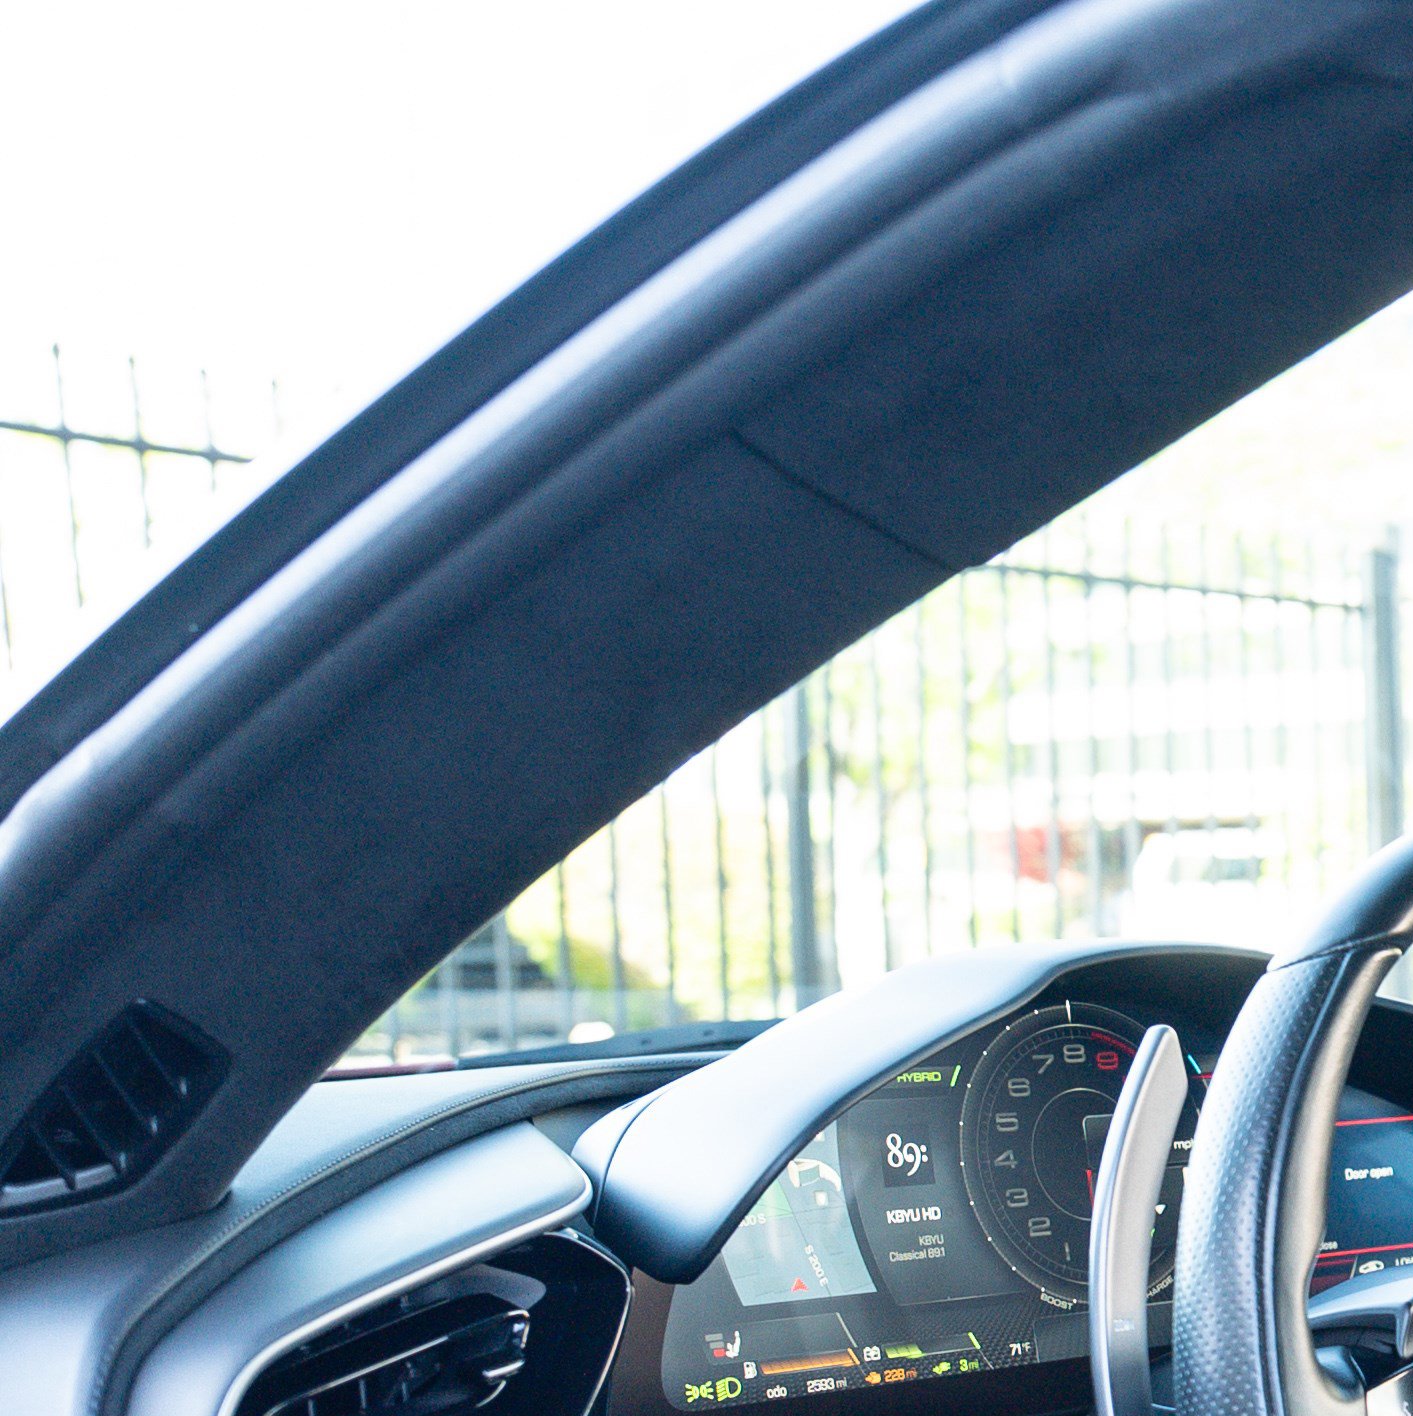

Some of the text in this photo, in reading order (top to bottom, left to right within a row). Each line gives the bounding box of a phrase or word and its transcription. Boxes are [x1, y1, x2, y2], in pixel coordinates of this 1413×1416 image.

[1063, 1044, 1086, 1063] 8
[1096, 1051, 1118, 1070] 9
[1032, 1054, 1055, 1074] 7
[1008, 1078, 1030, 1097] 6
[996, 1112, 1019, 1132] 5
[994, 1149, 1018, 1168] 4
[1344, 1166, 1394, 1181] Door open
[1005, 1188, 1029, 1207] 3
[886, 1206, 942, 1224] KBYU HD
[1028, 1217, 1052, 1237] 2
[918, 1233, 945, 1246] KBYU
[889, 1249, 927, 1262] Classical
[1040, 1292, 1074, 1310] BOOST
[883, 1368, 905, 1383] 228
[766, 1385, 787, 1398] odo
[806, 1378, 835, 1393] 2593
